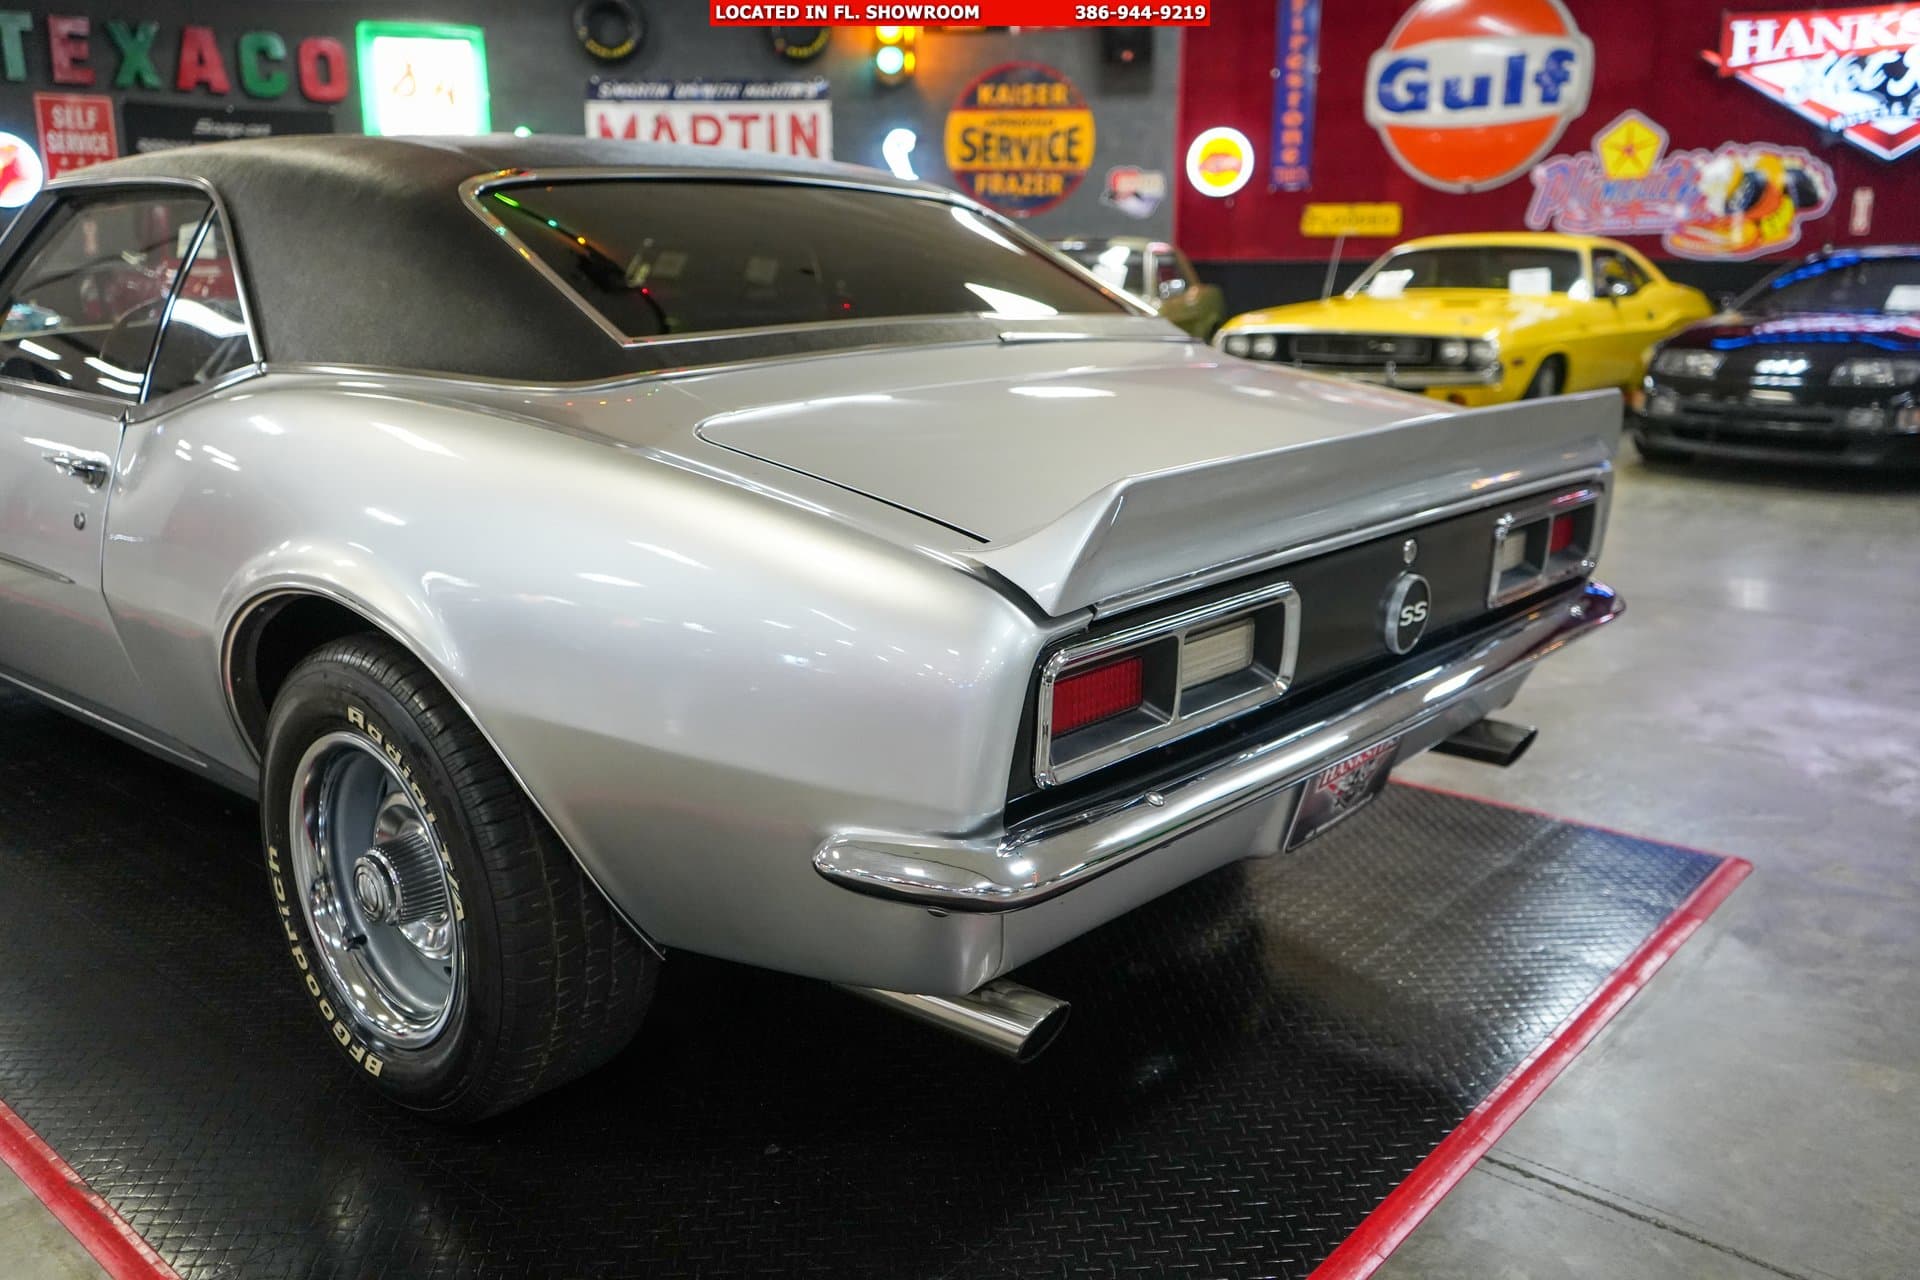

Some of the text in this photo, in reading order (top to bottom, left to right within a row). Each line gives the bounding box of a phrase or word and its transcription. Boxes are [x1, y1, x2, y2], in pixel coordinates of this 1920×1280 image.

[0, 10, 348, 102] TEXACO
[977, 82, 1070, 106] KAISER
[1378, 48, 1575, 113] Gulf
[52, 103, 97, 129] SELF
[47, 129, 109, 156] SERVICE
[961, 126, 1082, 163] SERVICE
[974, 172, 1065, 196] FRAZER
[1399, 600, 1428, 627] SS
